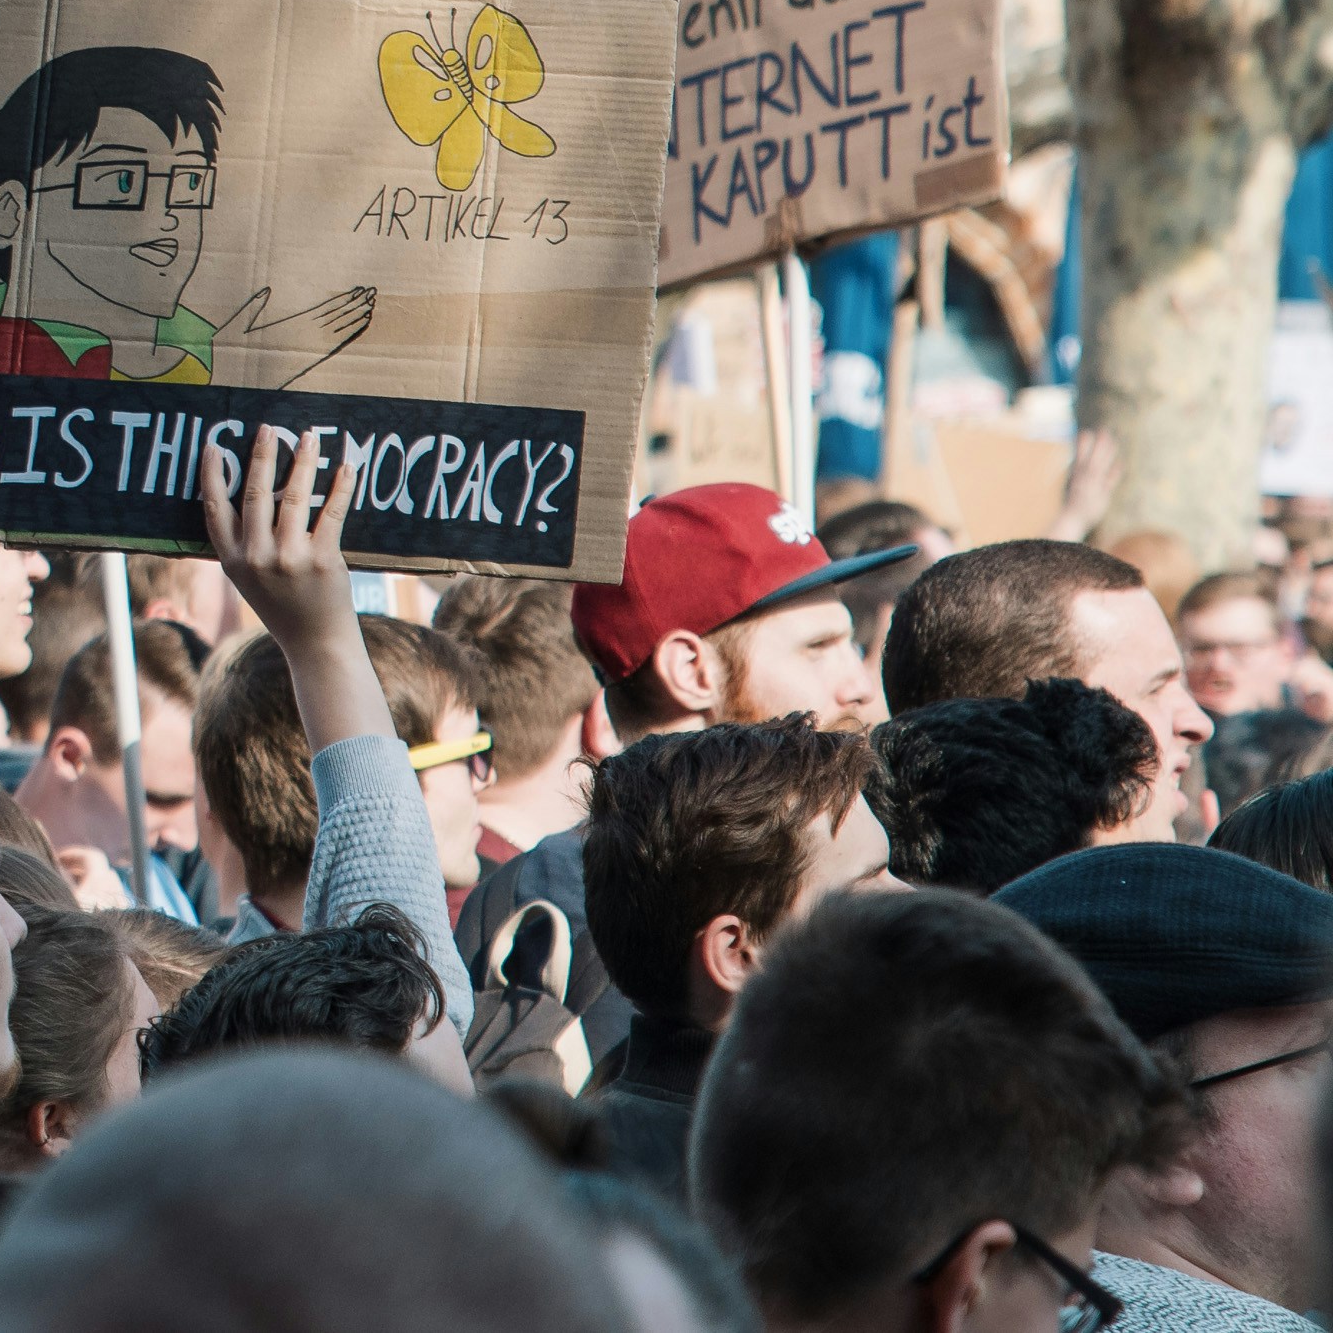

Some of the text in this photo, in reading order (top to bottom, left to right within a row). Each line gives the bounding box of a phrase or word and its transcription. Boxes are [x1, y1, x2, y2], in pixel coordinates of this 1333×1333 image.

[690, 75, 993, 245] KAPUTT ist
[352, 183, 572, 246] ARTIKEL 13
[0, 404, 96, 489] IS
[111, 410, 245, 502] THIS
